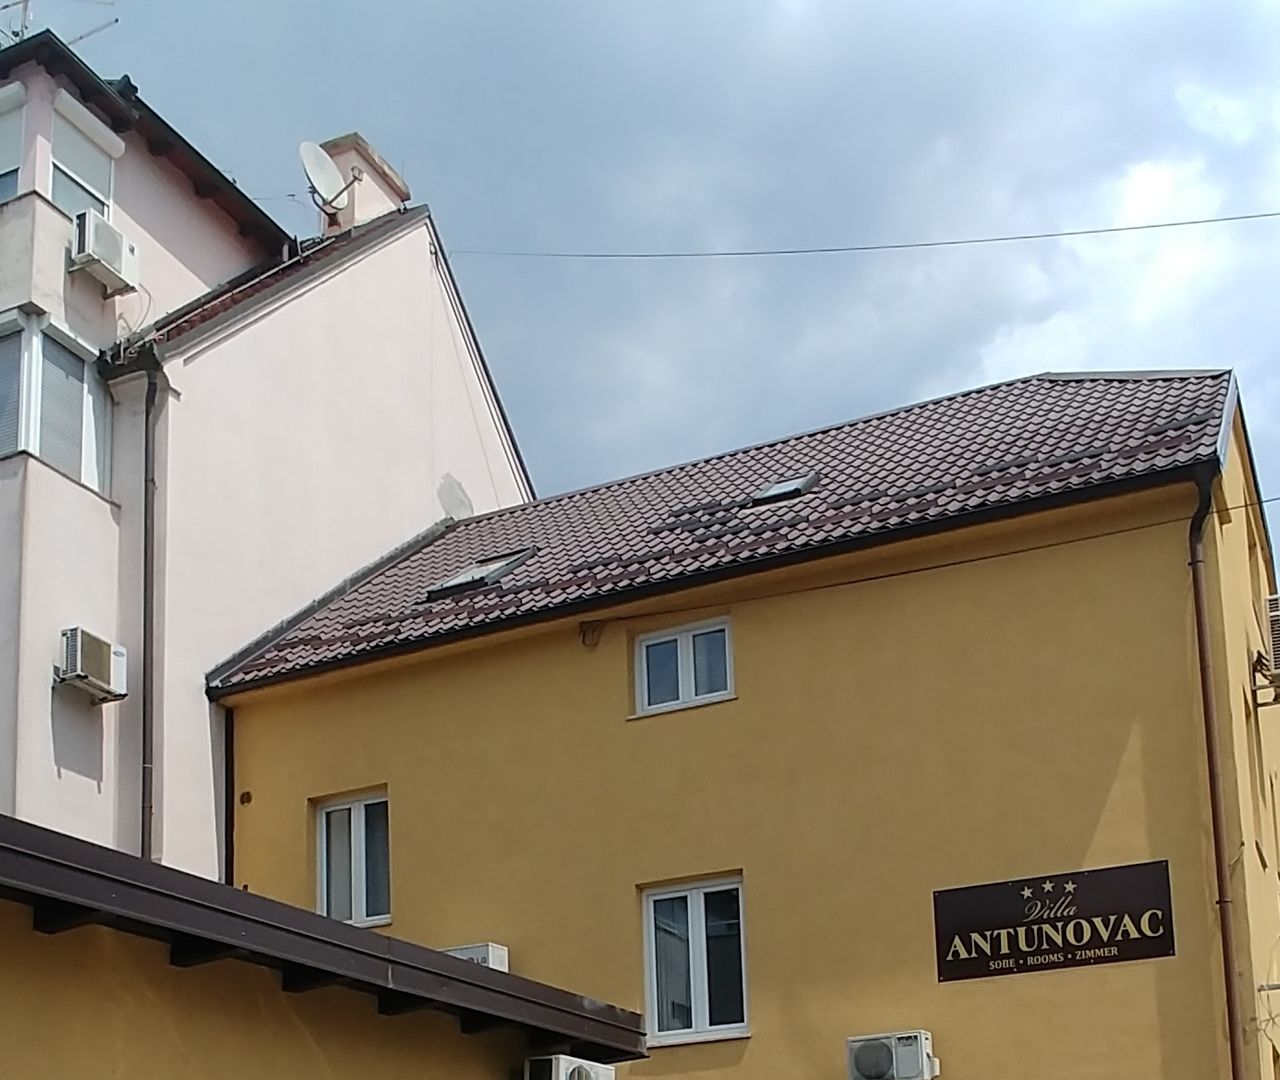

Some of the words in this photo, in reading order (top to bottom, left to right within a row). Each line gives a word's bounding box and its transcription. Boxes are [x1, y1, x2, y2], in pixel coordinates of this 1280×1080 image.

[1023, 896, 1078, 922] Villa
[946, 909, 1164, 960] ANTUNOVAC
[989, 958, 1016, 970] SOBE
[1027, 952, 1064, 966] ROOMS
[1075, 947, 1118, 960] ZIMMER
